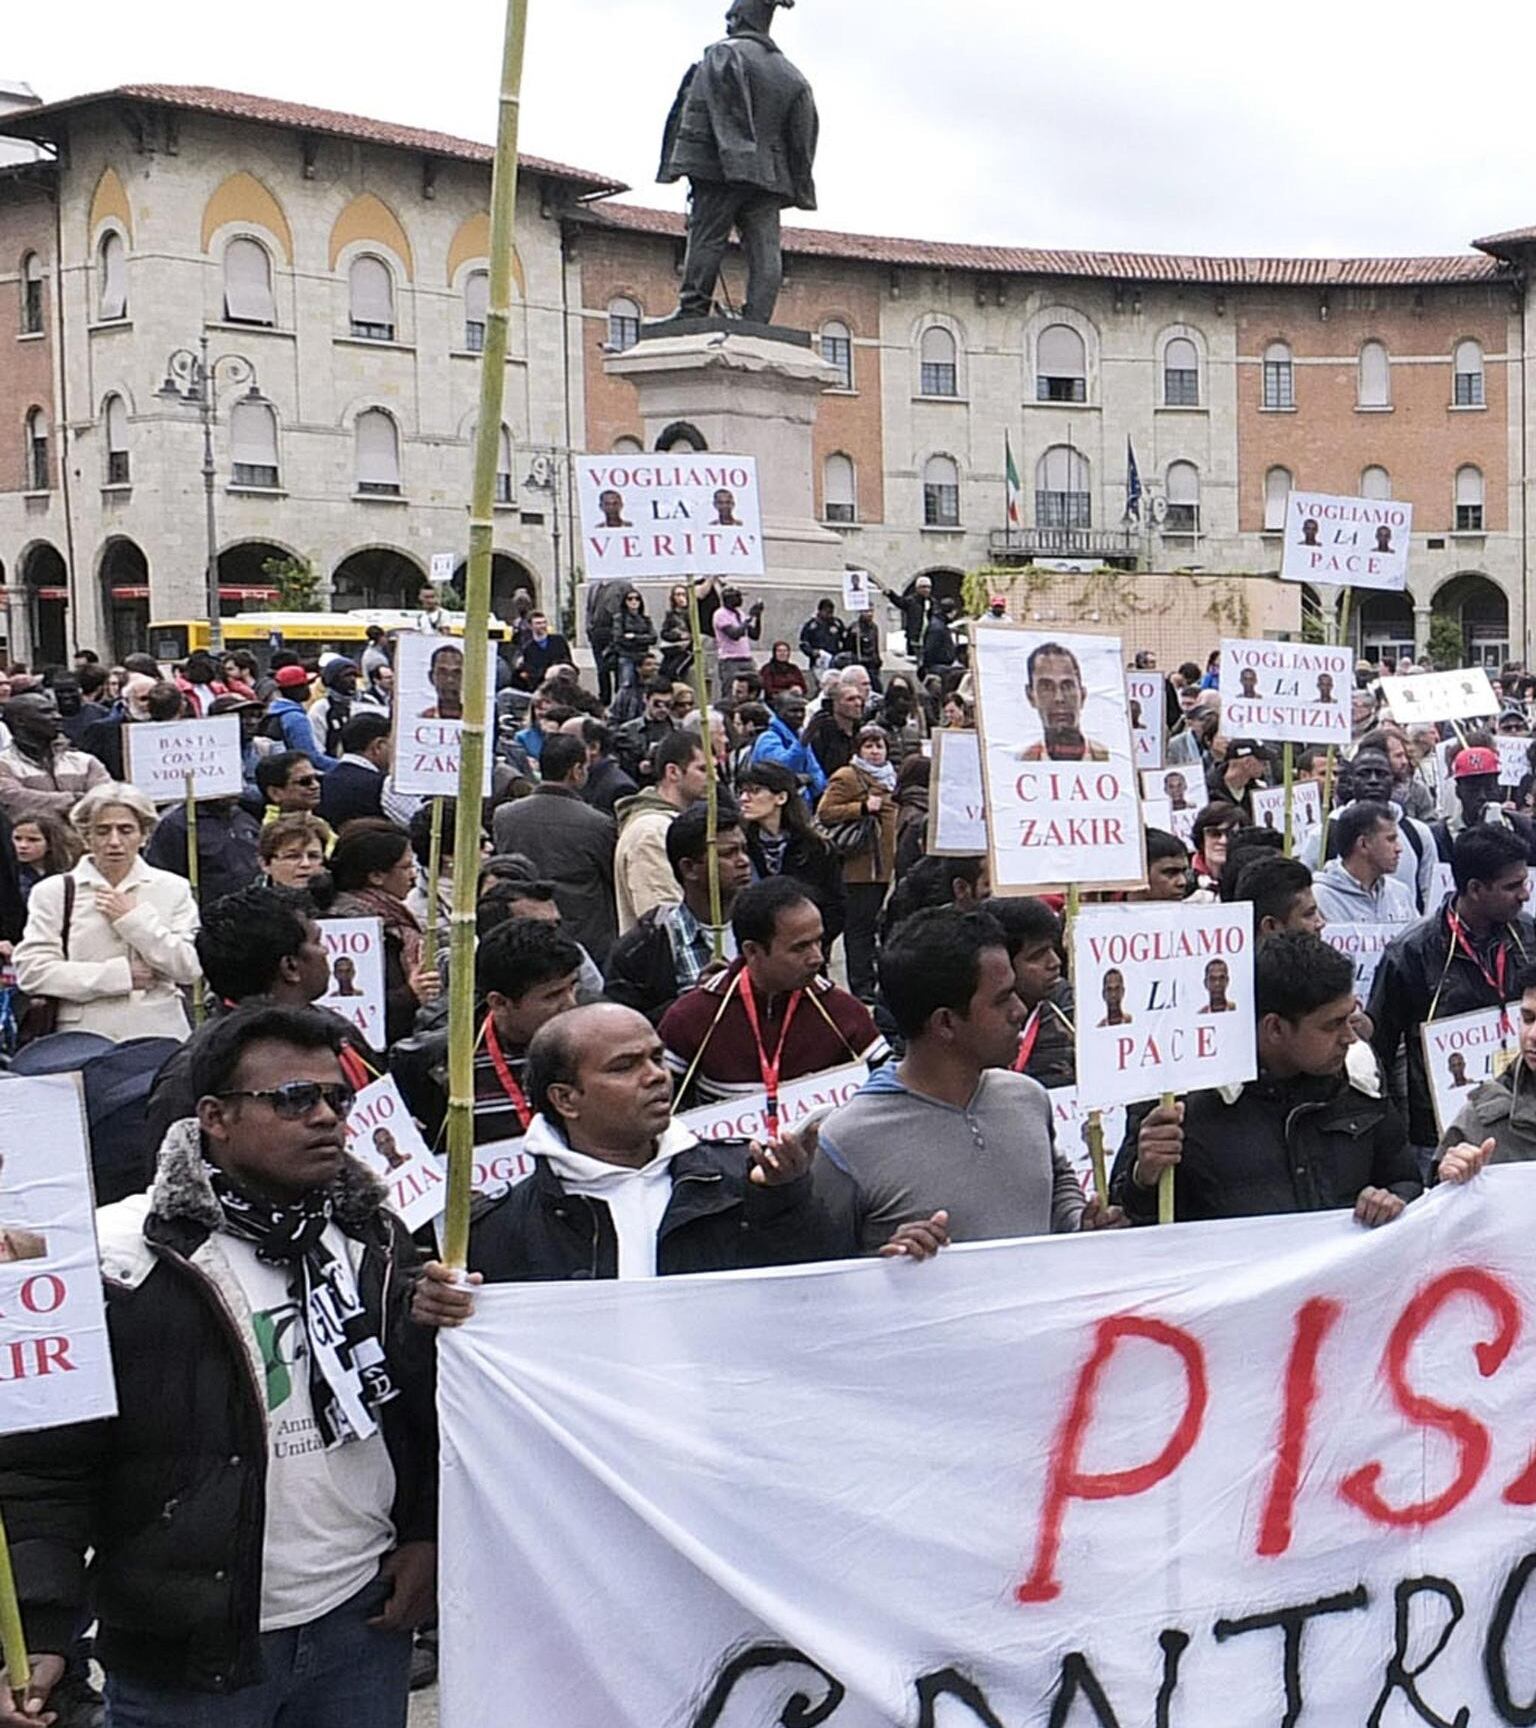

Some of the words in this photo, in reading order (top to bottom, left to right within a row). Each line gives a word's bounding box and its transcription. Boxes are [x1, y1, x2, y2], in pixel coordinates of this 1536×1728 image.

[588, 467, 748, 487] VOGLIAMO
[651, 500, 692, 520] LA
[1296, 501, 1405, 526] VOGLIAMO
[590, 534, 755, 558] VERITA'
[1334, 529, 1358, 545] LA
[1310, 551, 1381, 574] PACE
[1231, 649, 1346, 673] VOGLIAMO
[1274, 678, 1300, 697] LA
[1227, 705, 1348, 729] GIUSTIZIA
[160, 735, 216, 749] BASTA
[162, 753, 193, 764] CON
[153, 766, 224, 780] VIOLNZA
[1015, 774, 1120, 801] CIAO
[1019, 818, 1125, 847] ZAKIR
[1089, 926, 1245, 964] VOGLIAMO
[1117, 1026, 1217, 1071] PACE
